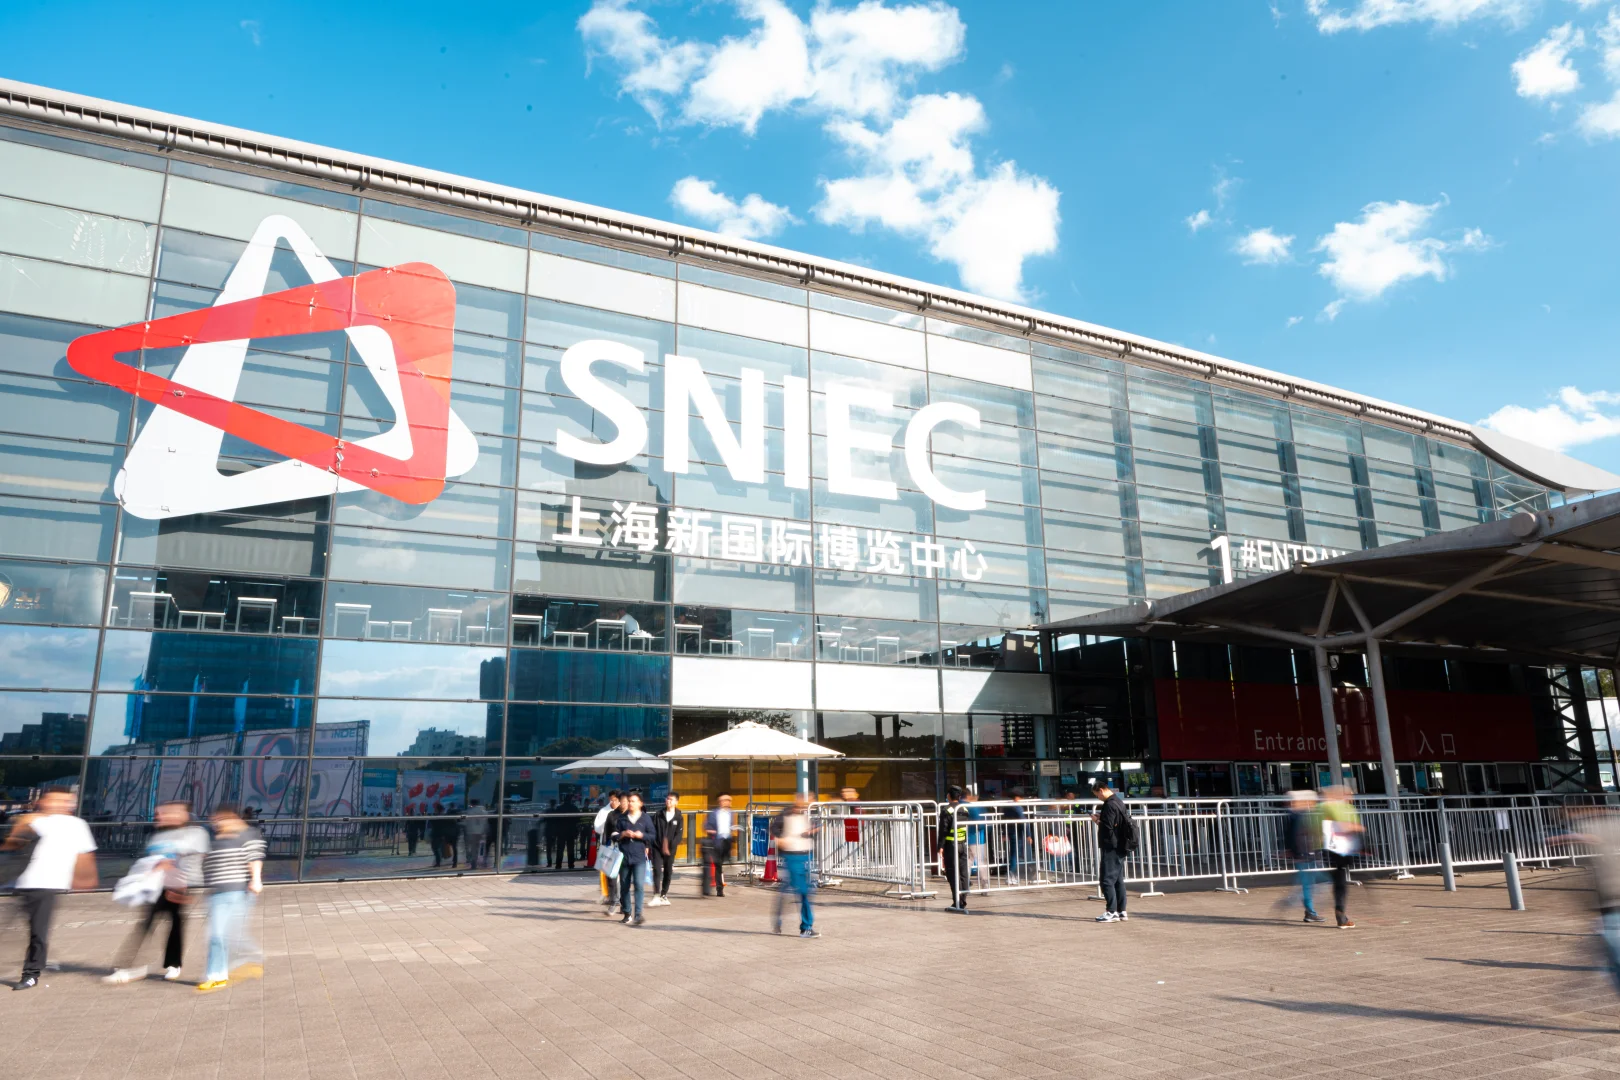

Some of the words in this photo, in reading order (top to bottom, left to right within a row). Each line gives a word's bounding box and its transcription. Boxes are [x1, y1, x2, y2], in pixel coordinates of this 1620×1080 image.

[556, 339, 987, 511] SNIEC
[552, 495, 988, 582] 上海新国际博览中心
[1254, 729, 1328, 751] Entranc
[1418, 729, 1457, 756] 入口
